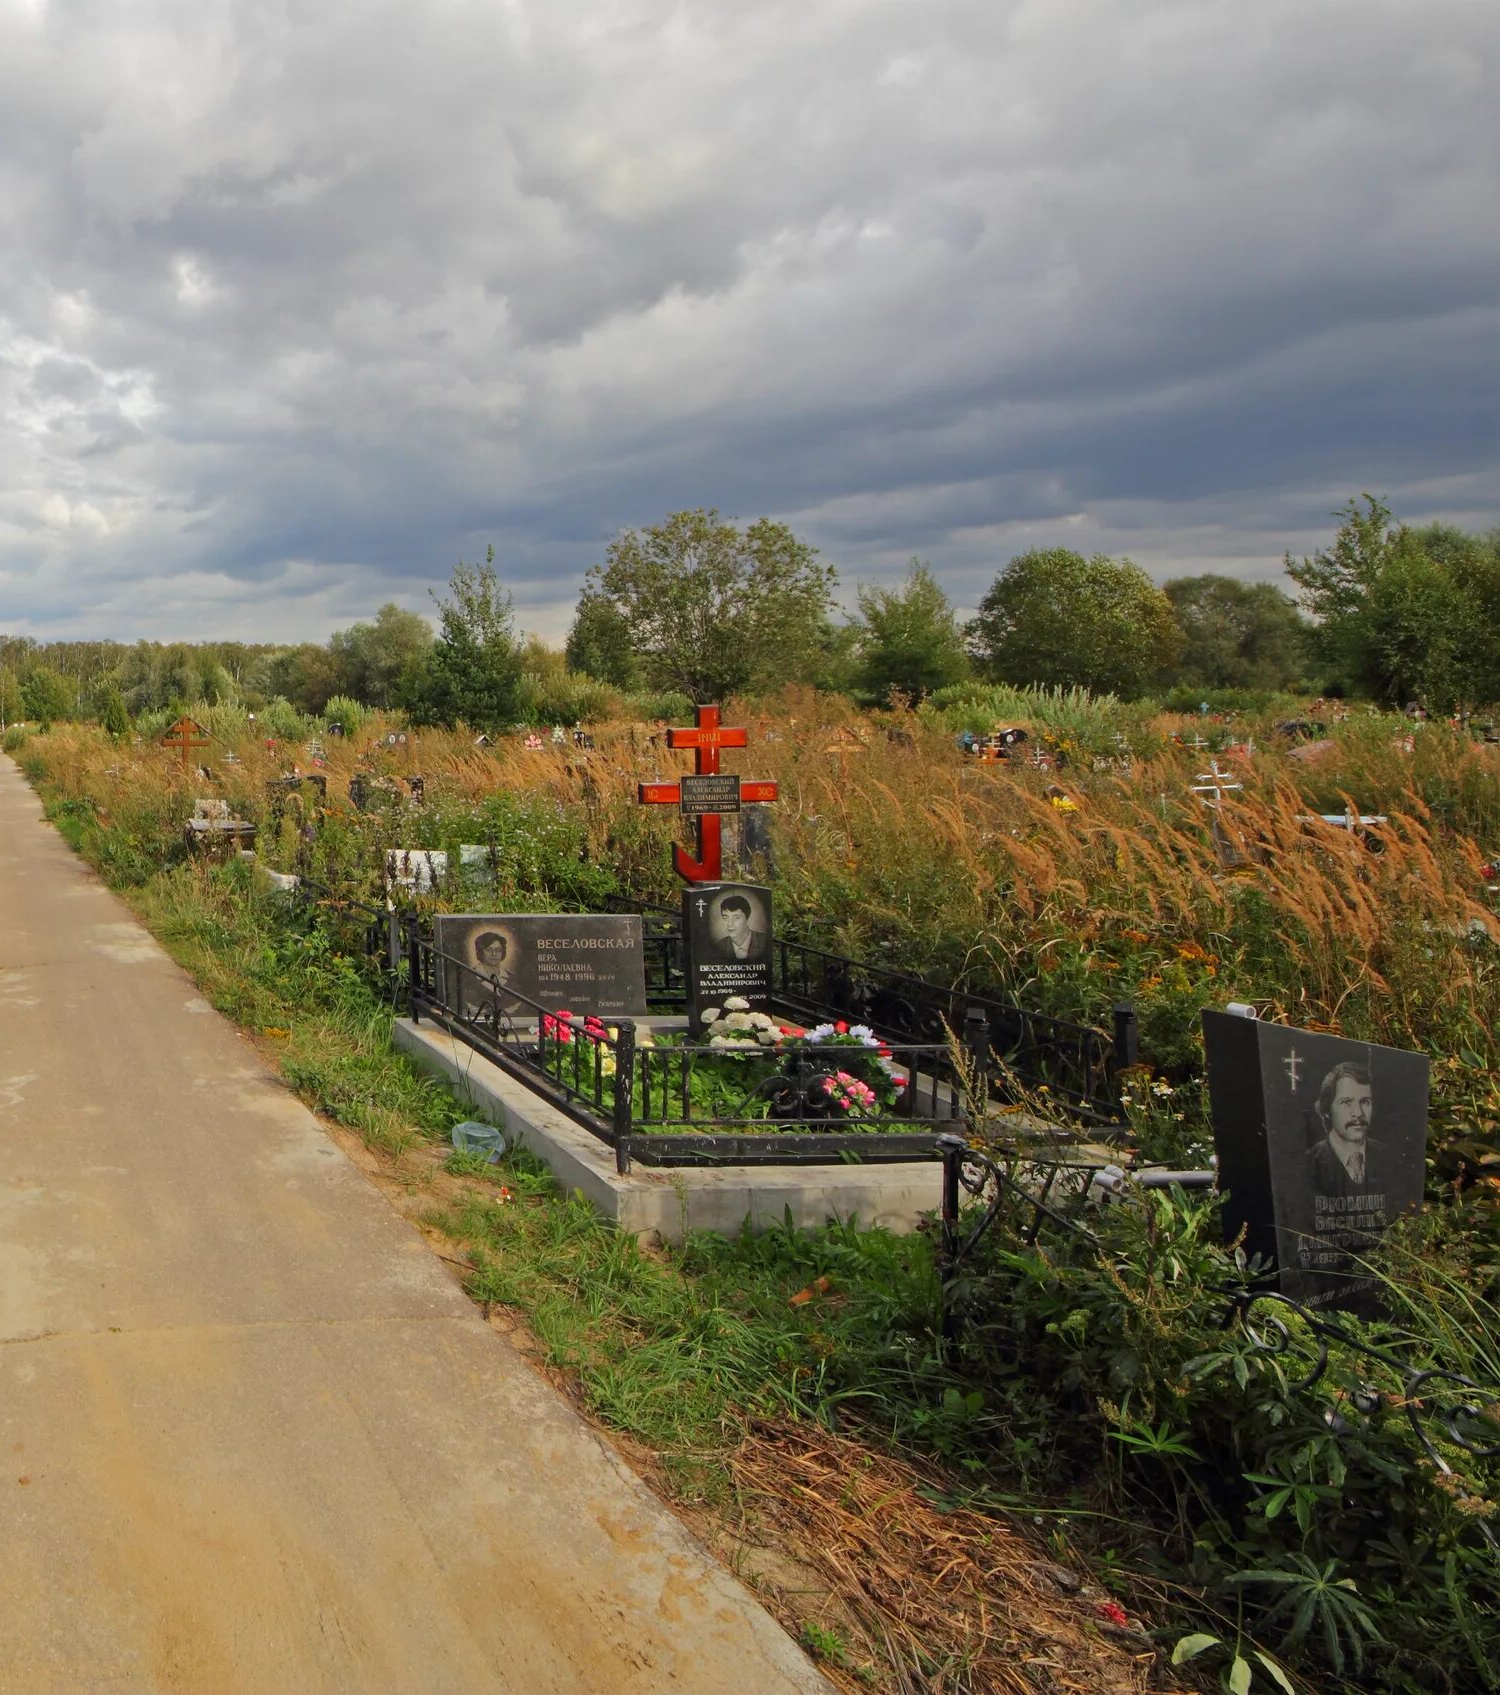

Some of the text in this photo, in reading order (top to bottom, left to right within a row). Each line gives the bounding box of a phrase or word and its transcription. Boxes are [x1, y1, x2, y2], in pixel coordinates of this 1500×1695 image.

[683, 793, 739, 801] ВЛАДИМИРОВИЧ
[537, 938, 635, 949] ВЕСЕЛОВСКАЯ
[537, 954, 557, 962] ВЕРА
[538, 963, 593, 972] НИКОЛАЕВНА
[699, 963, 767, 972] ВЕСЕЛОВСКИЙ
[550, 973, 571, 981] 1948
[575, 973, 595, 981] 1996
[1315, 1194, 1386, 1213] РЮМИН
